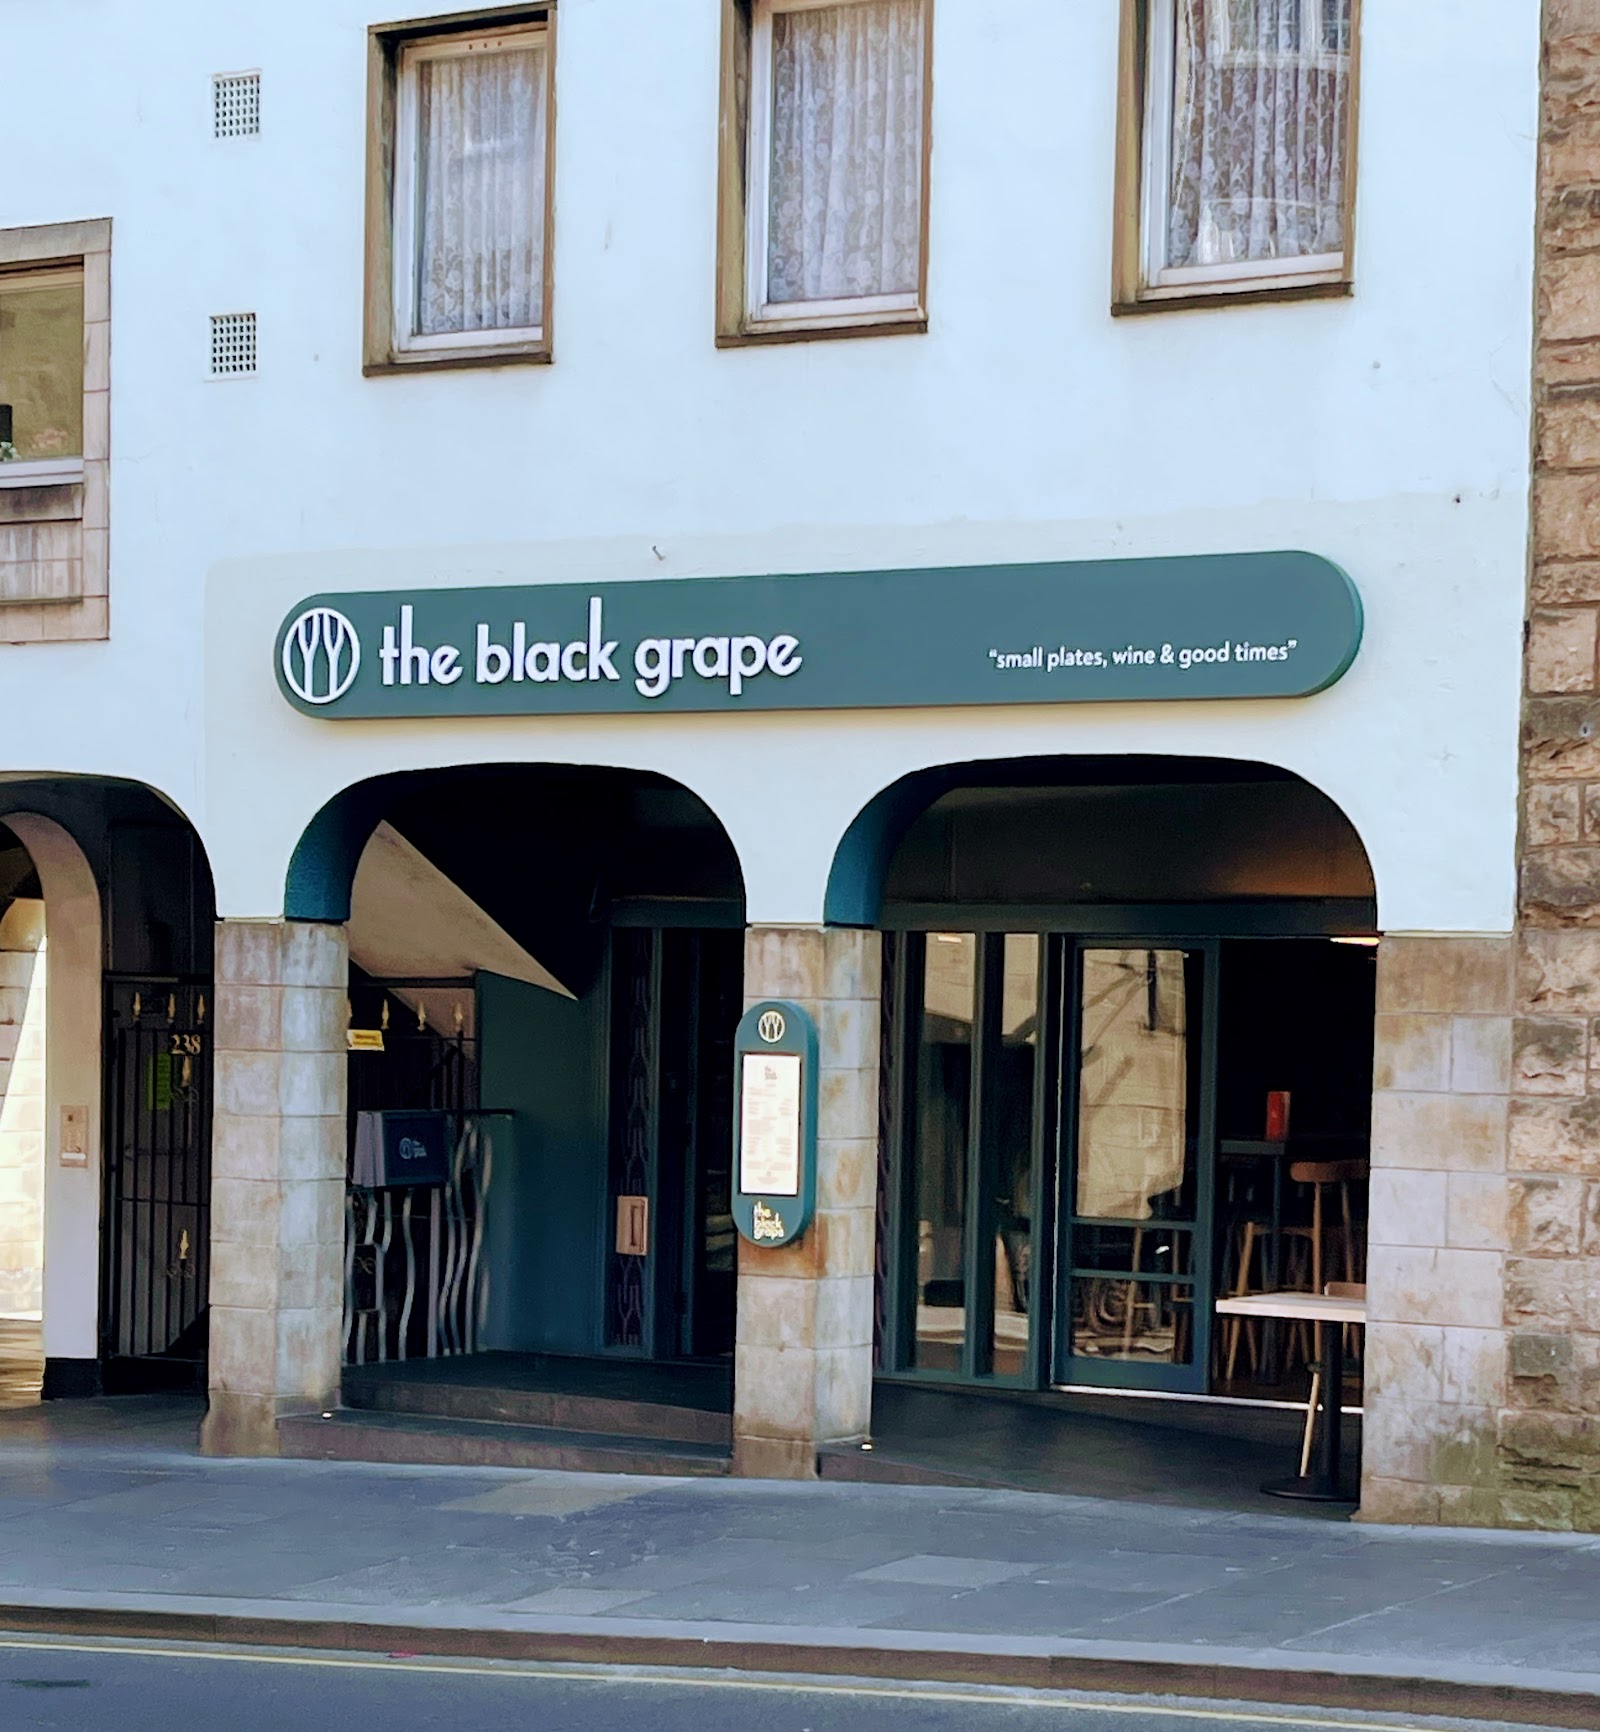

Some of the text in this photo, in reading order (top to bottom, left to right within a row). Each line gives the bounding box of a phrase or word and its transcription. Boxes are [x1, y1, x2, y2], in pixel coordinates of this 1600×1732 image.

[379, 596, 803, 697] the black grape
[1047, 646, 1108, 673] plates,
[1112, 645, 1156, 665] wine
[1159, 644, 1175, 665] &
[1178, 641, 1230, 669] good
